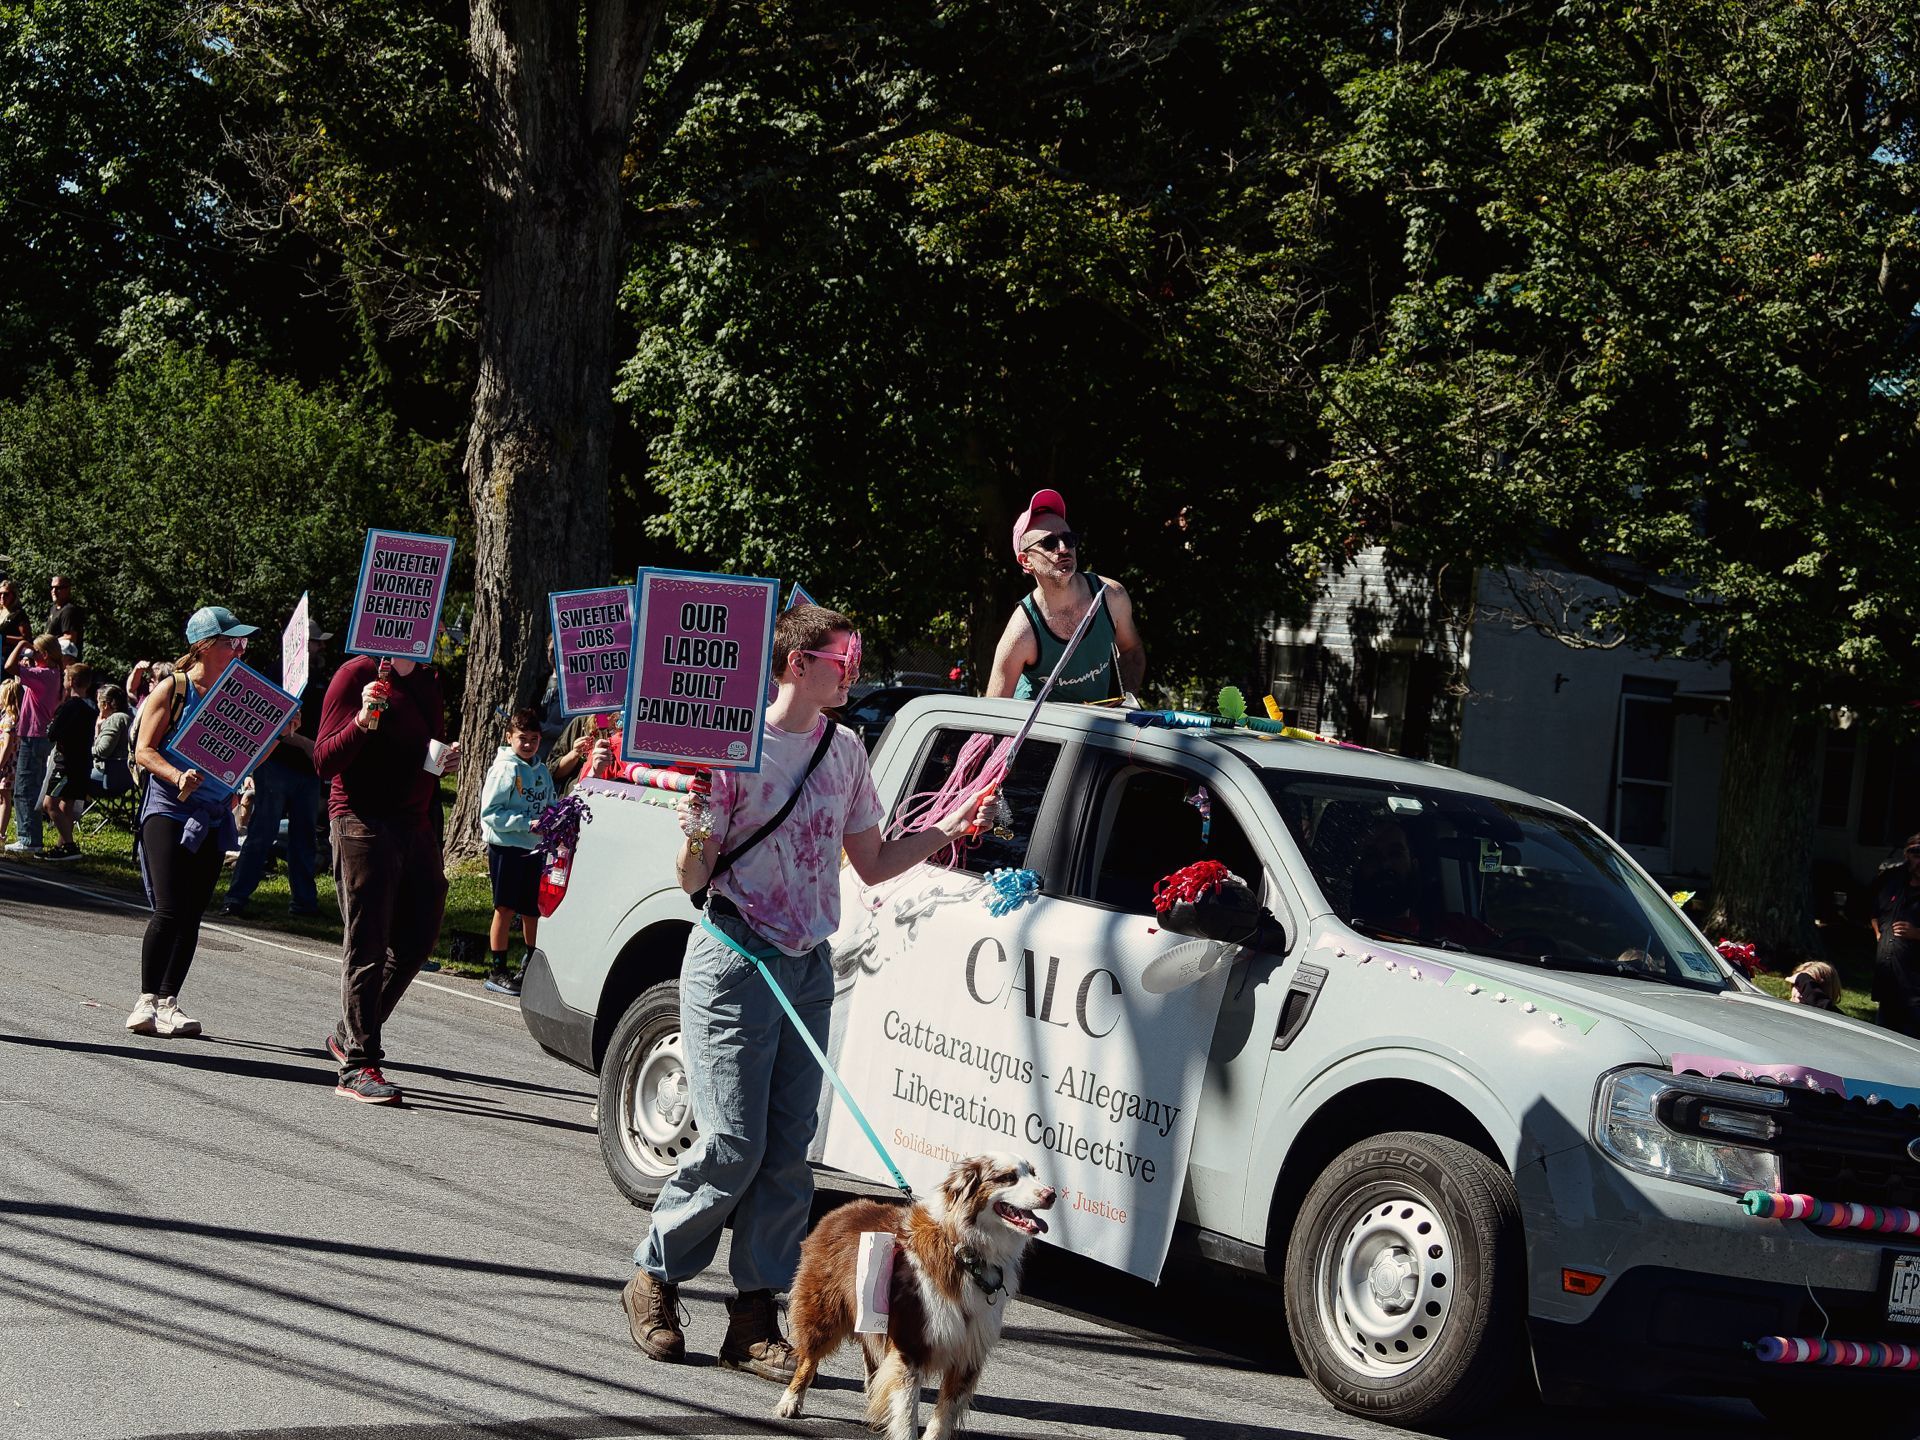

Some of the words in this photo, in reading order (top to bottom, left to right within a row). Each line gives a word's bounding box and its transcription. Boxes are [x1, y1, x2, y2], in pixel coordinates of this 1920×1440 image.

[373, 549, 441, 575] SWEETEN
[372, 572, 434, 598] WORKER
[364, 594, 431, 619] BENEFITS
[559, 603, 626, 629] SWEETEN
[680, 602, 728, 634] OUR
[373, 618, 414, 640] NOW!
[577, 627, 614, 649] JOBS
[568, 653, 596, 674] NOT
[600, 651, 628, 671] CEO
[663, 635, 739, 670] LABOR
[586, 674, 614, 695] PAY
[670, 672, 726, 700] BUILT
[1038, 659, 1110, 687] hampio
[220, 676, 244, 698] NO
[240, 689, 284, 725] SUGAR
[637, 697, 755, 733] CANDYLAND
[215, 697, 265, 736] COATED
[196, 709, 261, 758] CORPORATE
[197, 732, 236, 763] GREED
[965, 937, 1123, 1039] CALC
[1297, 973, 1317, 985] XL
[883, 1010, 1034, 1085] Cattaraugus
[1055, 1066, 1181, 1137] Allegany
[892, 1068, 1017, 1138] Liberation
[1025, 1112, 1156, 1183] Collective
[894, 1128, 960, 1168] Solidarity
[1072, 1191, 1128, 1224] Justice
